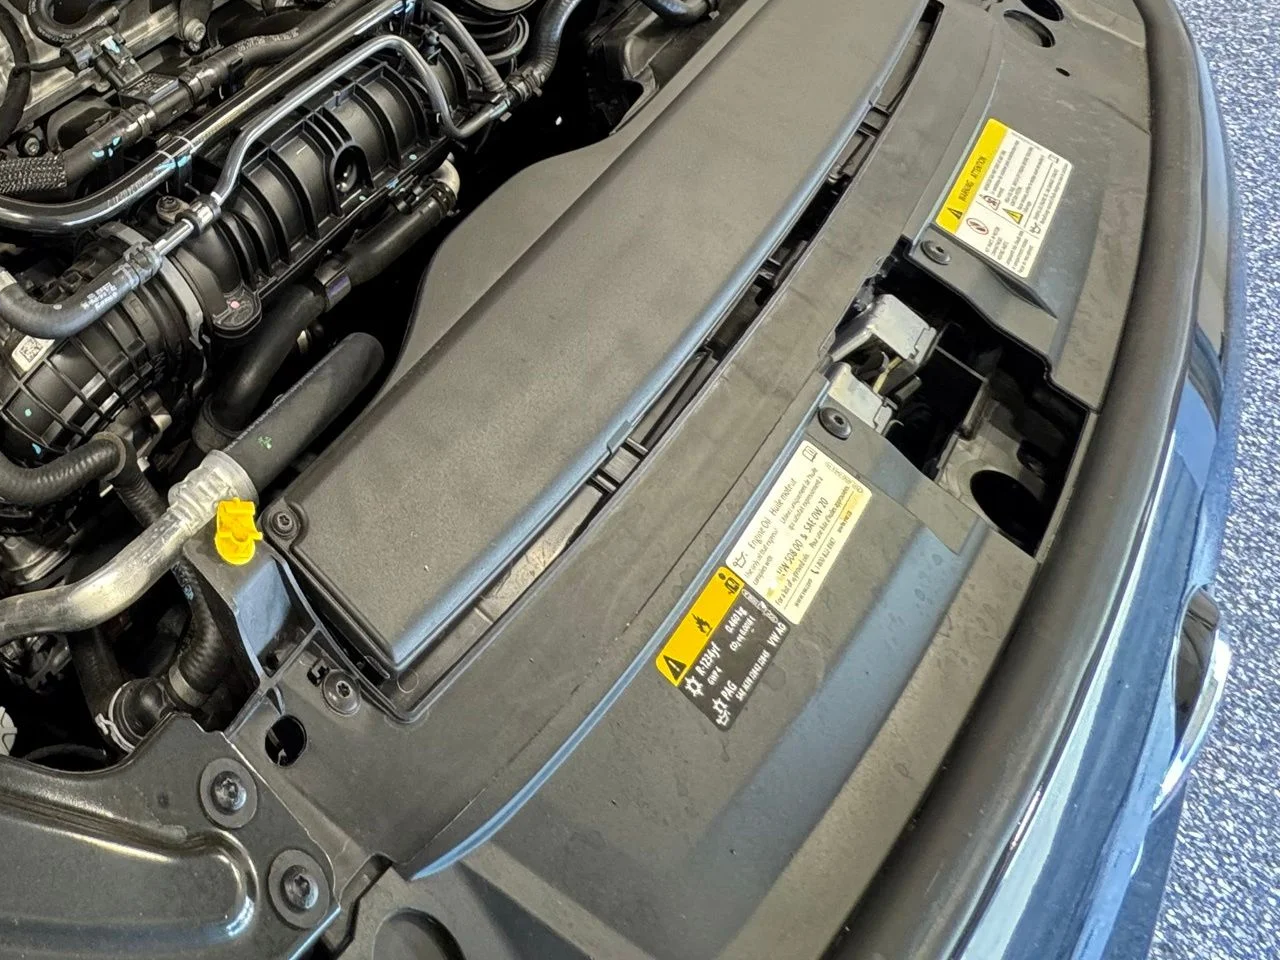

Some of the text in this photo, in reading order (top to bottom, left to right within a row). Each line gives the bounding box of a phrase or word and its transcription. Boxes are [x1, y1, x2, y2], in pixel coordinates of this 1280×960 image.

[971, 156, 987, 179] ATTENTION
[748, 527, 765, 549] Engine
[761, 517, 771, 529] Oil
[780, 478, 797, 500] moteur
[784, 549, 798, 564] 508
[792, 539, 803, 551] 00
[803, 518, 816, 533] SAE
[818, 497, 828, 508] 20
[695, 606, 748, 676] R-1234yf 0.460 kg
[767, 631, 780, 647] VW
[775, 622, 787, 636] AG
[707, 670, 719, 685] GWP
[721, 680, 737, 701] PAG
